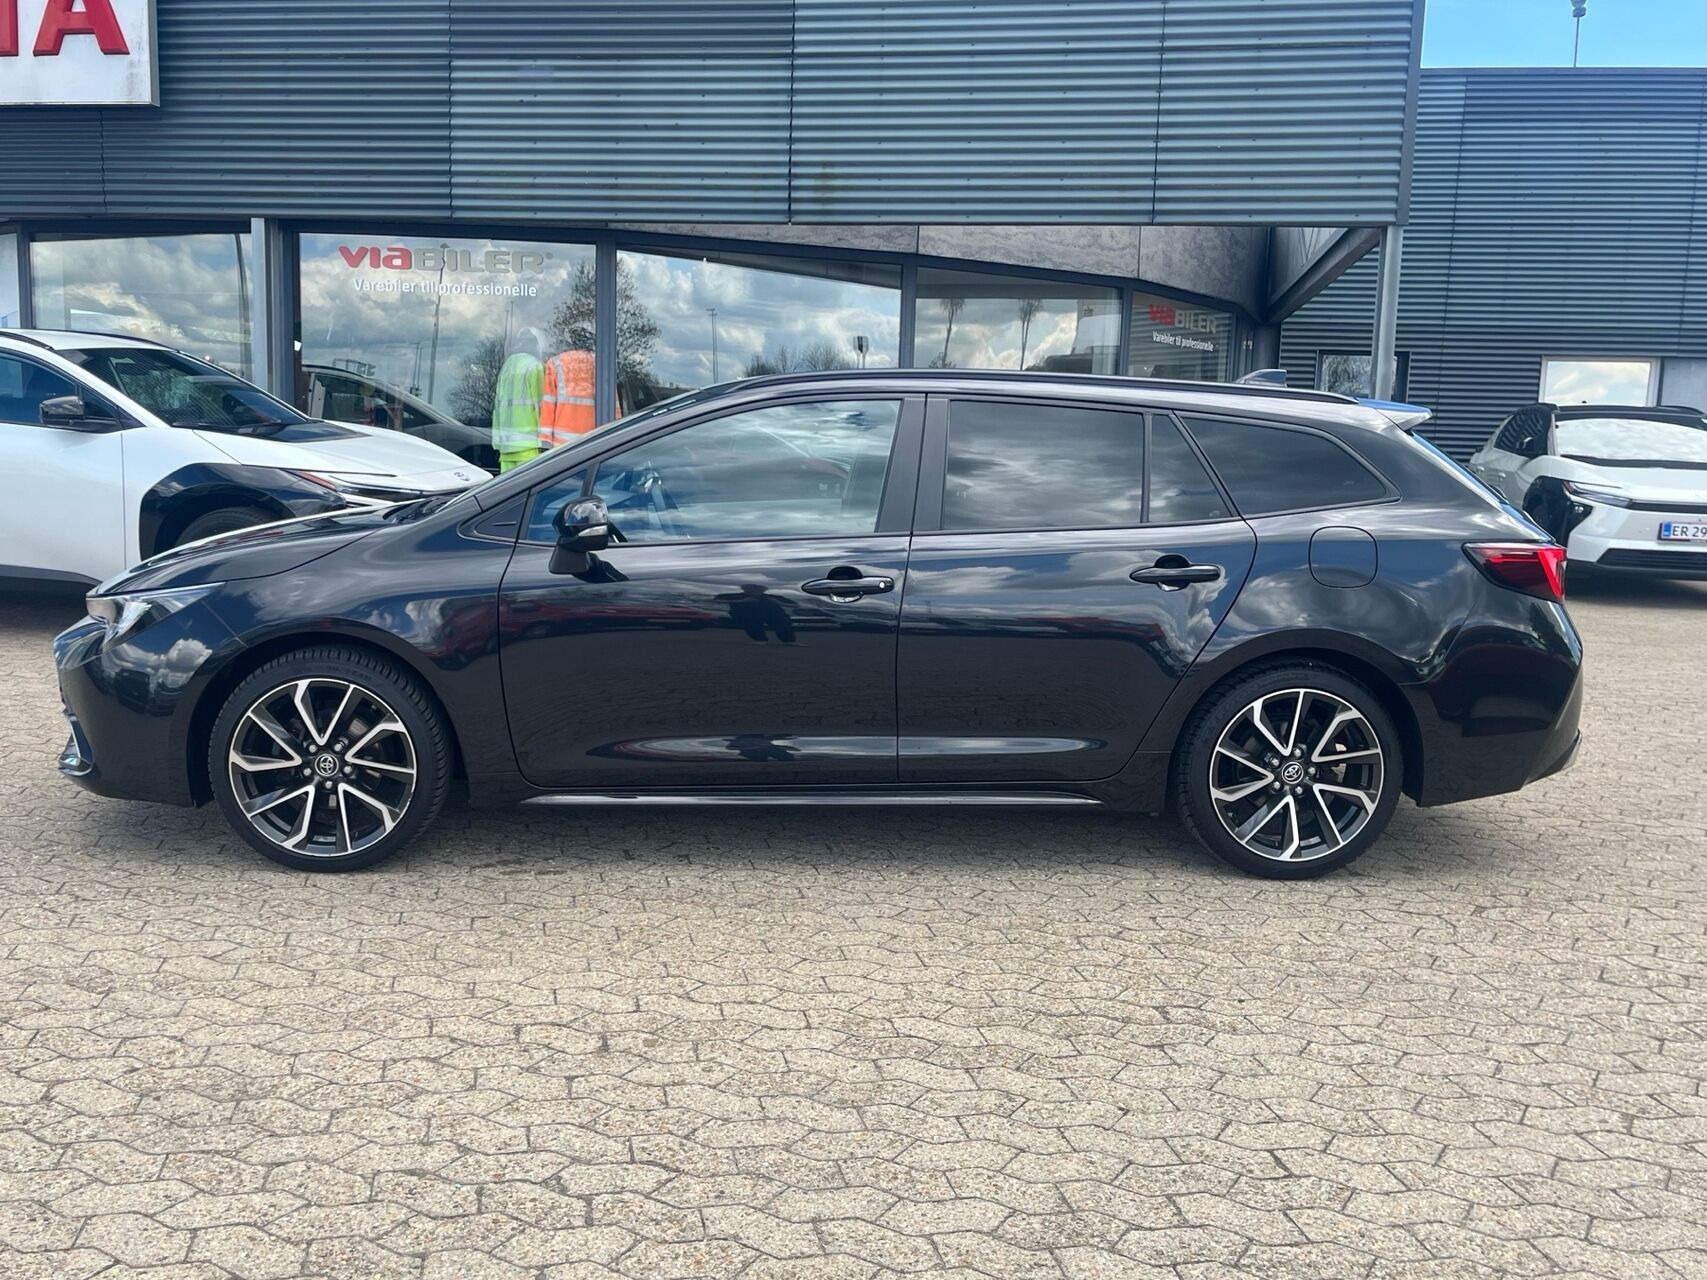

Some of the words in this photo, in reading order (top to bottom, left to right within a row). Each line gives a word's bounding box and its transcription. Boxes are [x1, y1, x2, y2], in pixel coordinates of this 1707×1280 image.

[354, 279, 416, 293] Varebiler
[420, 280, 436, 293] til
[439, 282, 537, 297] professionelle
[1153, 331, 1175, 345] Varebiler
[1672, 525, 1689, 537] ER
